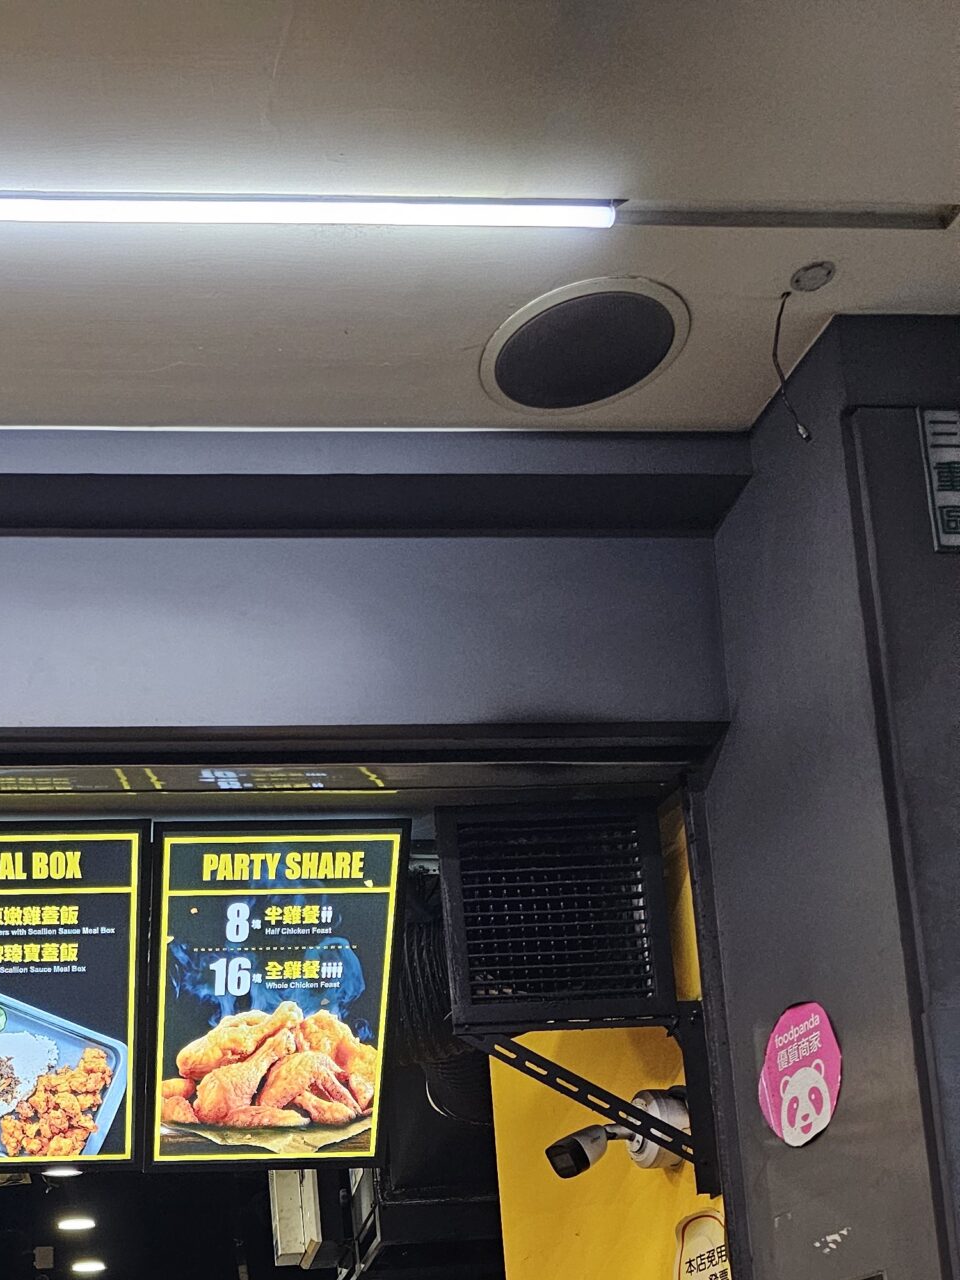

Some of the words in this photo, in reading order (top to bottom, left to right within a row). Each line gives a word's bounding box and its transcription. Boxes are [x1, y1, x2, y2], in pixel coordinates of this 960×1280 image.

[32, 851, 82, 880] BOX
[202, 853, 281, 881] PARTY
[285, 851, 365, 880] SHARE
[264, 905, 321, 926] 半雞餐
[11, 928, 27, 936] with
[27, 928, 57, 936] Scallion
[82, 927, 100, 935] Meal
[100, 927, 115, 935] Box
[311, 927, 332, 935] Feast
[264, 960, 321, 980] 全雞餐
[265, 981, 288, 989] Whole
[289, 981, 319, 989] Chicken
[320, 981, 340, 989] Feast
[775, 1013, 820, 1048] foodpanda
[777, 1031, 822, 1072] 優質商家
[685, 1244, 729, 1276] 本店免用
